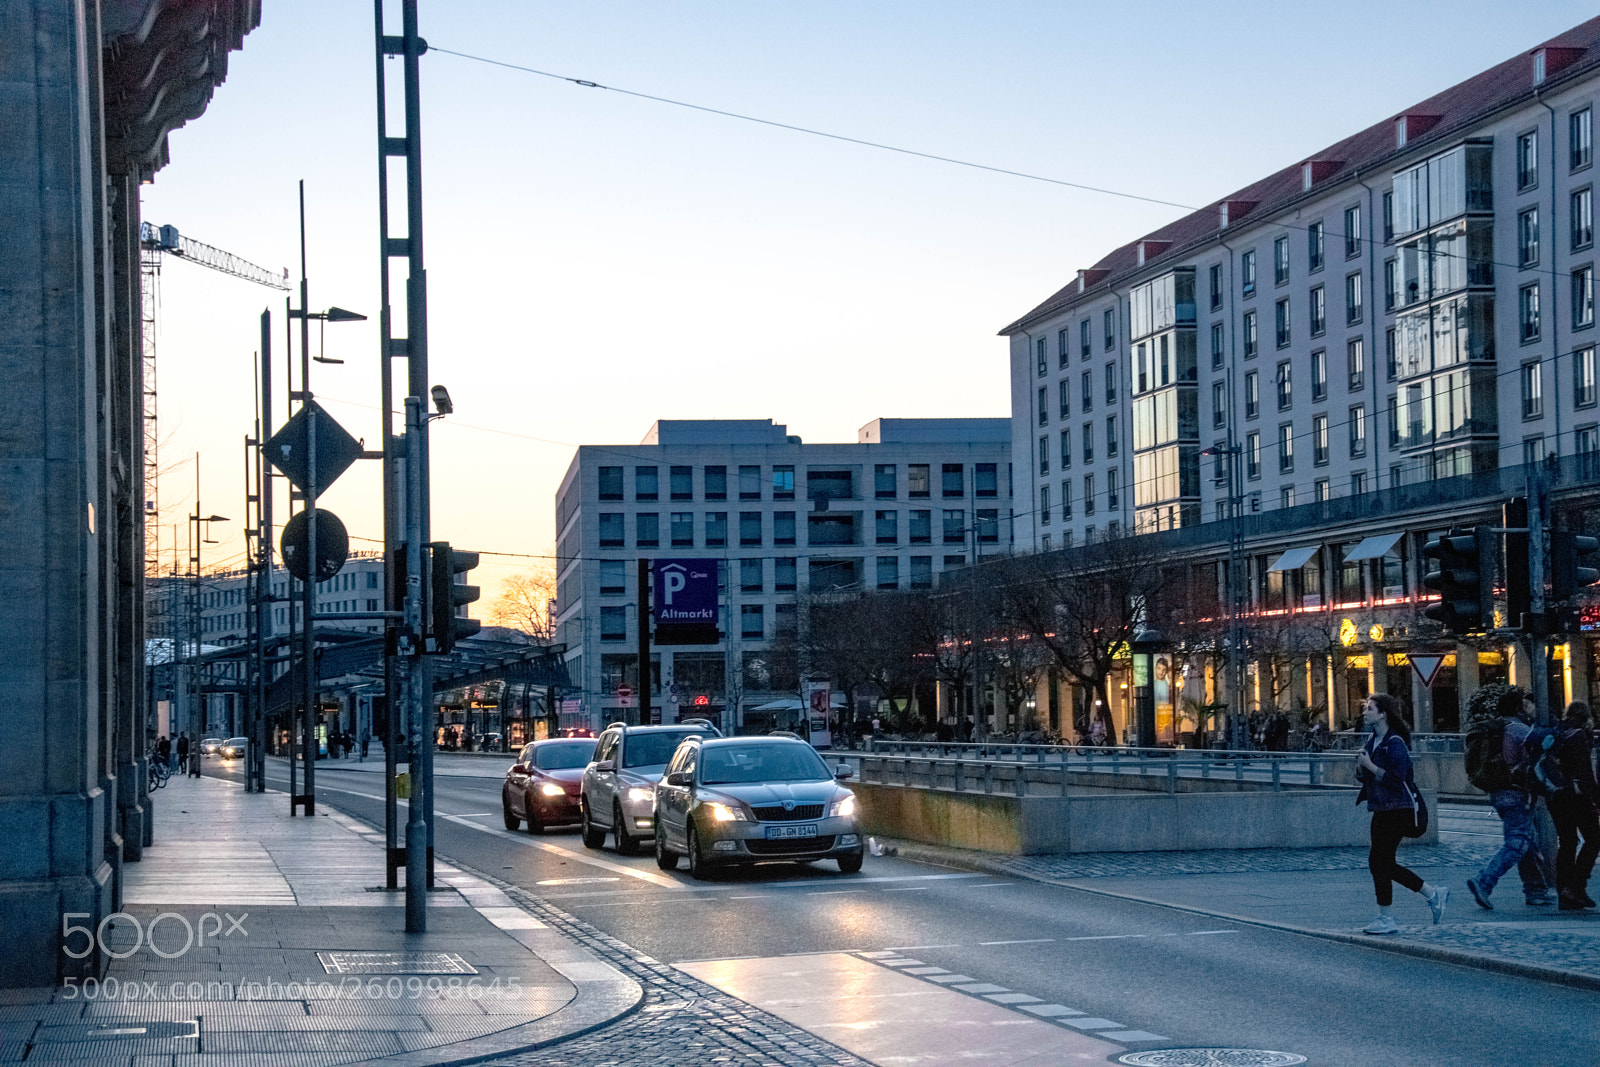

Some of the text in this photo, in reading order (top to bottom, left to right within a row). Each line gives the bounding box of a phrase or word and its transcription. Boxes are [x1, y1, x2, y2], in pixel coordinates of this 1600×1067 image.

[1252, 498, 1260, 512] E
[664, 571, 686, 605] P
[661, 609, 713, 618] Altmarkt
